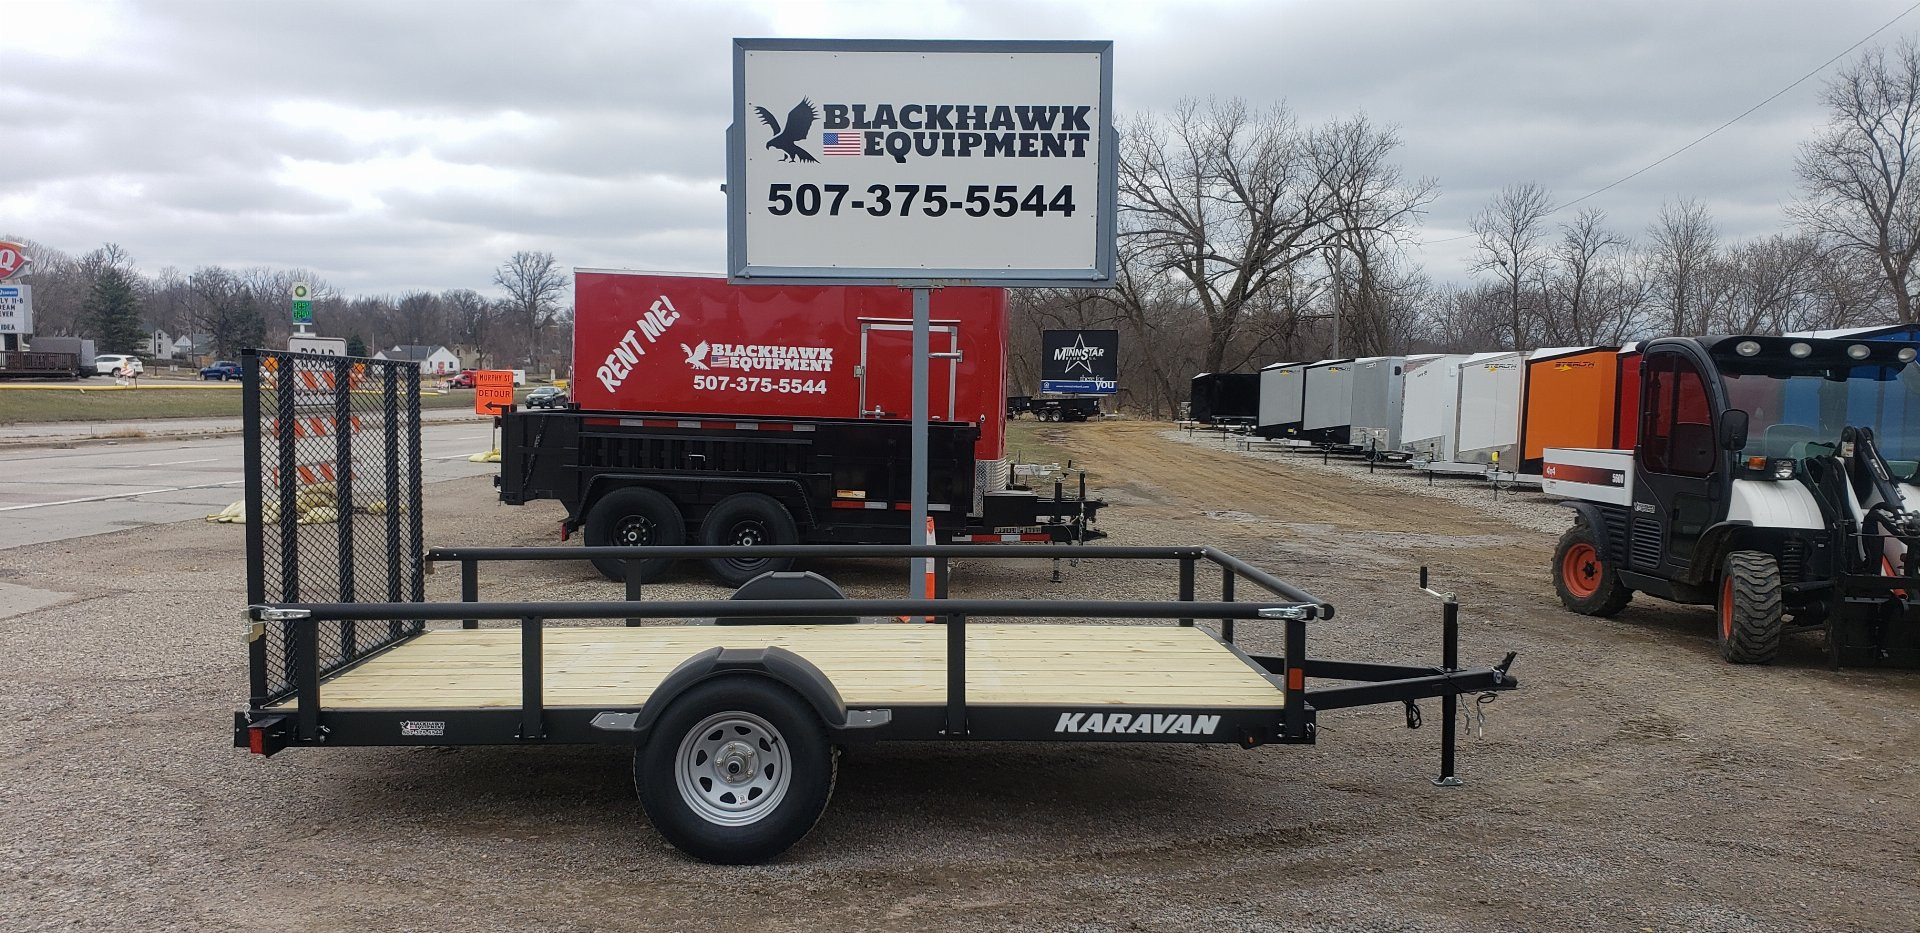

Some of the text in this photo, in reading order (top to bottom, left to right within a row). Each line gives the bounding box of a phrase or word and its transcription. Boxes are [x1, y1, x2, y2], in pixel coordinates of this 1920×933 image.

[823, 104, 1091, 131] BLACKHAWK
[864, 132, 1090, 163] EQUIPMENT
[767, 183, 1076, 217] 507-375-5544
[597, 295, 680, 393] RENT ME!
[711, 343, 833, 360] BLACKHAWK
[730, 356, 832, 372] EQUIPMENT
[478, 389, 511, 397] DETOUR
[693, 375, 827, 394] 507-375-5544
[1095, 381, 1114, 390] you
[1054, 712, 1221, 735] KARAVAN
